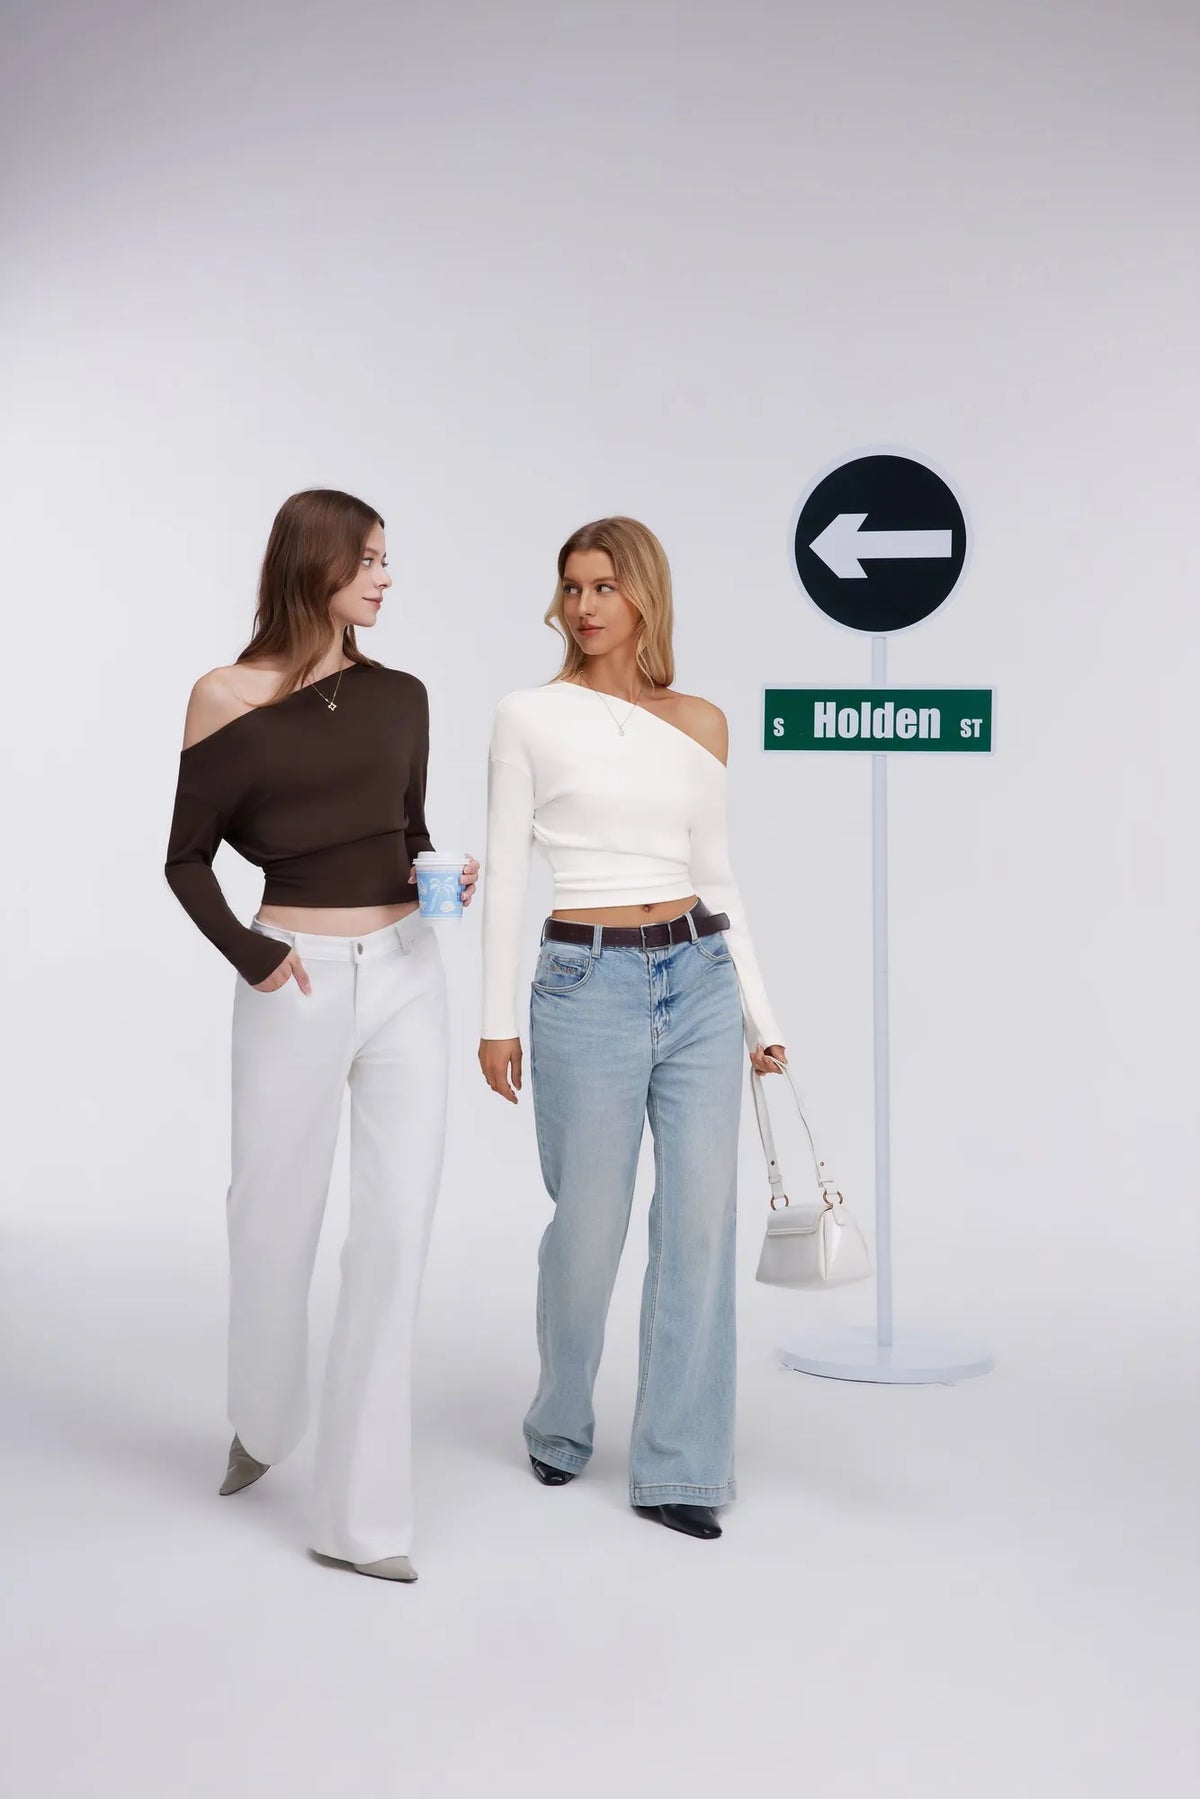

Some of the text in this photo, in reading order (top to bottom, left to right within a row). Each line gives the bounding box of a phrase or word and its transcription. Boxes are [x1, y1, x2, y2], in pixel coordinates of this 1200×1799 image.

[773, 701, 983, 739] S Holden ST
